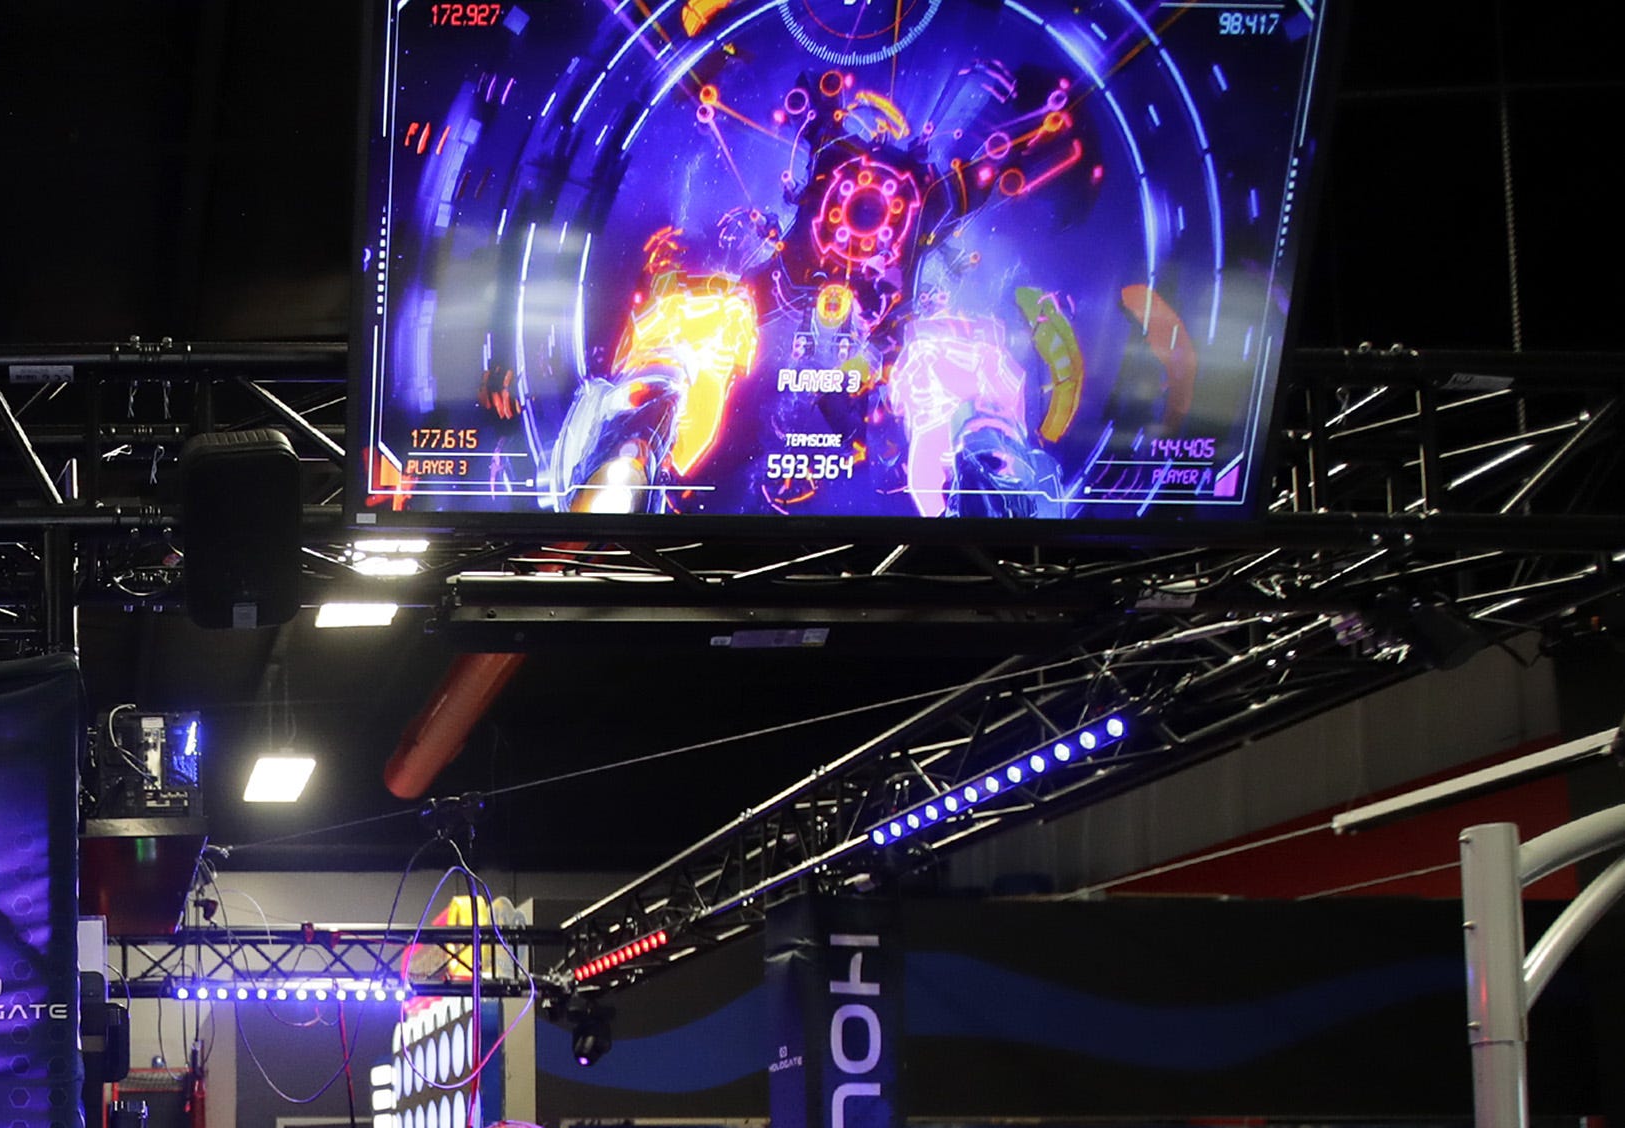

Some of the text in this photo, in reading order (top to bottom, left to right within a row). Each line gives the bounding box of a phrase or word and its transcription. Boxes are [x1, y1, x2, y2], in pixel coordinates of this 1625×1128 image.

[777, 369, 861, 392] PLAYER 3
[785, 434, 842, 447] TEAMSCORE
[406, 460, 468, 475] PLAYER 3
[1151, 469, 1198, 485] PLAYER
